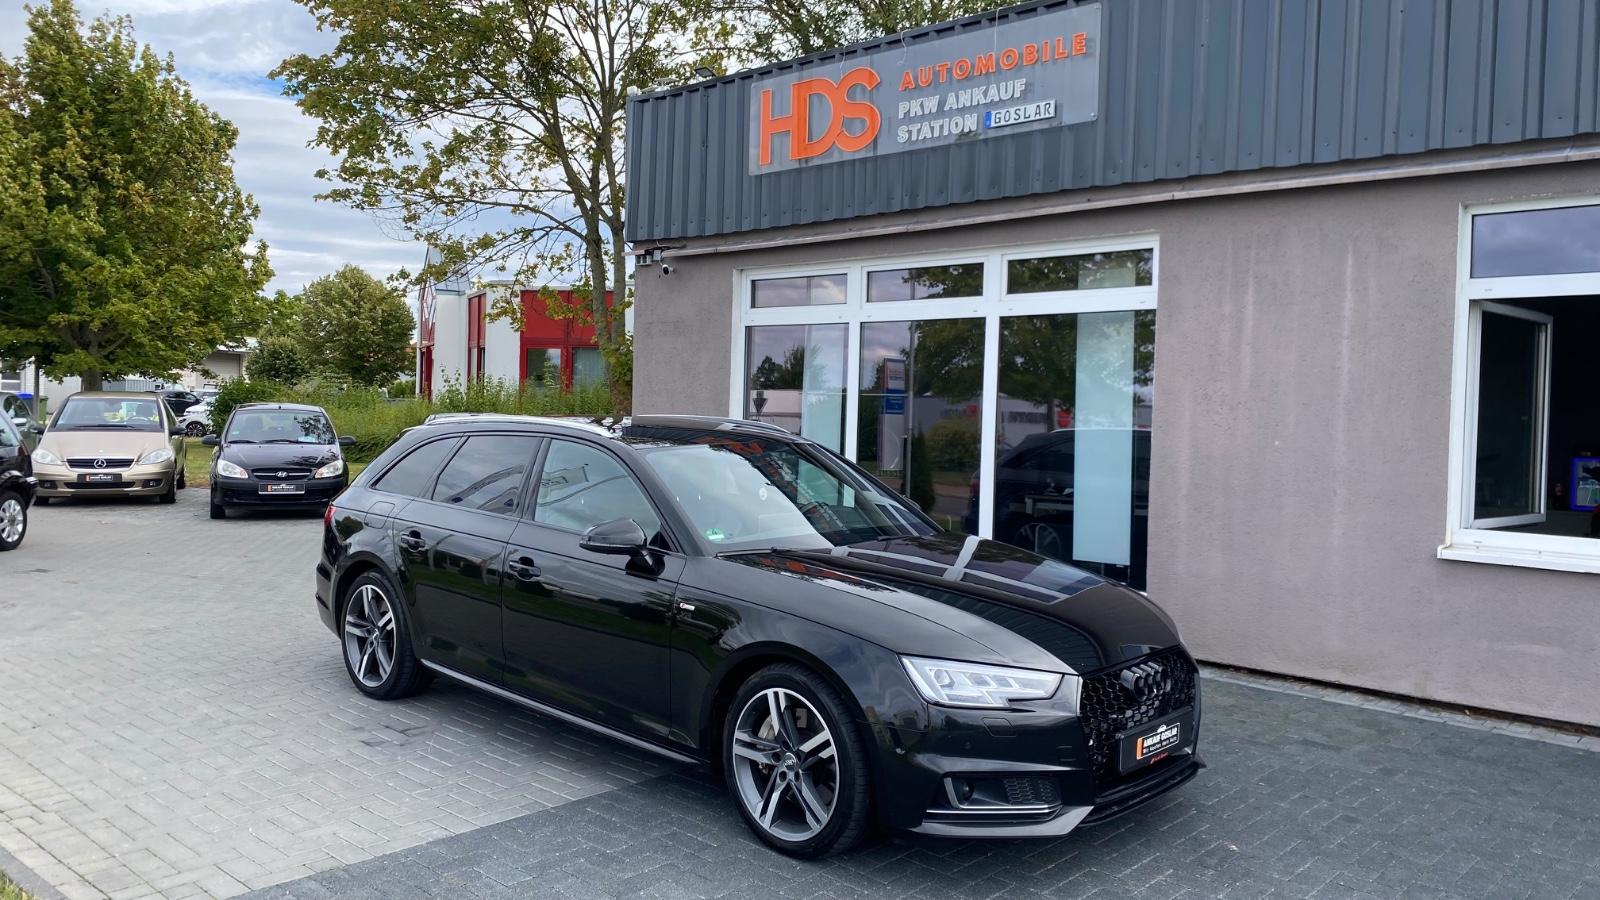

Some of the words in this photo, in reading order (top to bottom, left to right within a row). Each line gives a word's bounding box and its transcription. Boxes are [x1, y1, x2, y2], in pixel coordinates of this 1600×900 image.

[899, 32, 1087, 91] AUTOMOBILE
[759, 66, 881, 166] HDS
[897, 113, 977, 143] STATION
[994, 102, 1051, 124] GOSLAR
[898, 95, 940, 119] PKW
[944, 78, 1026, 111] ANKAUF
